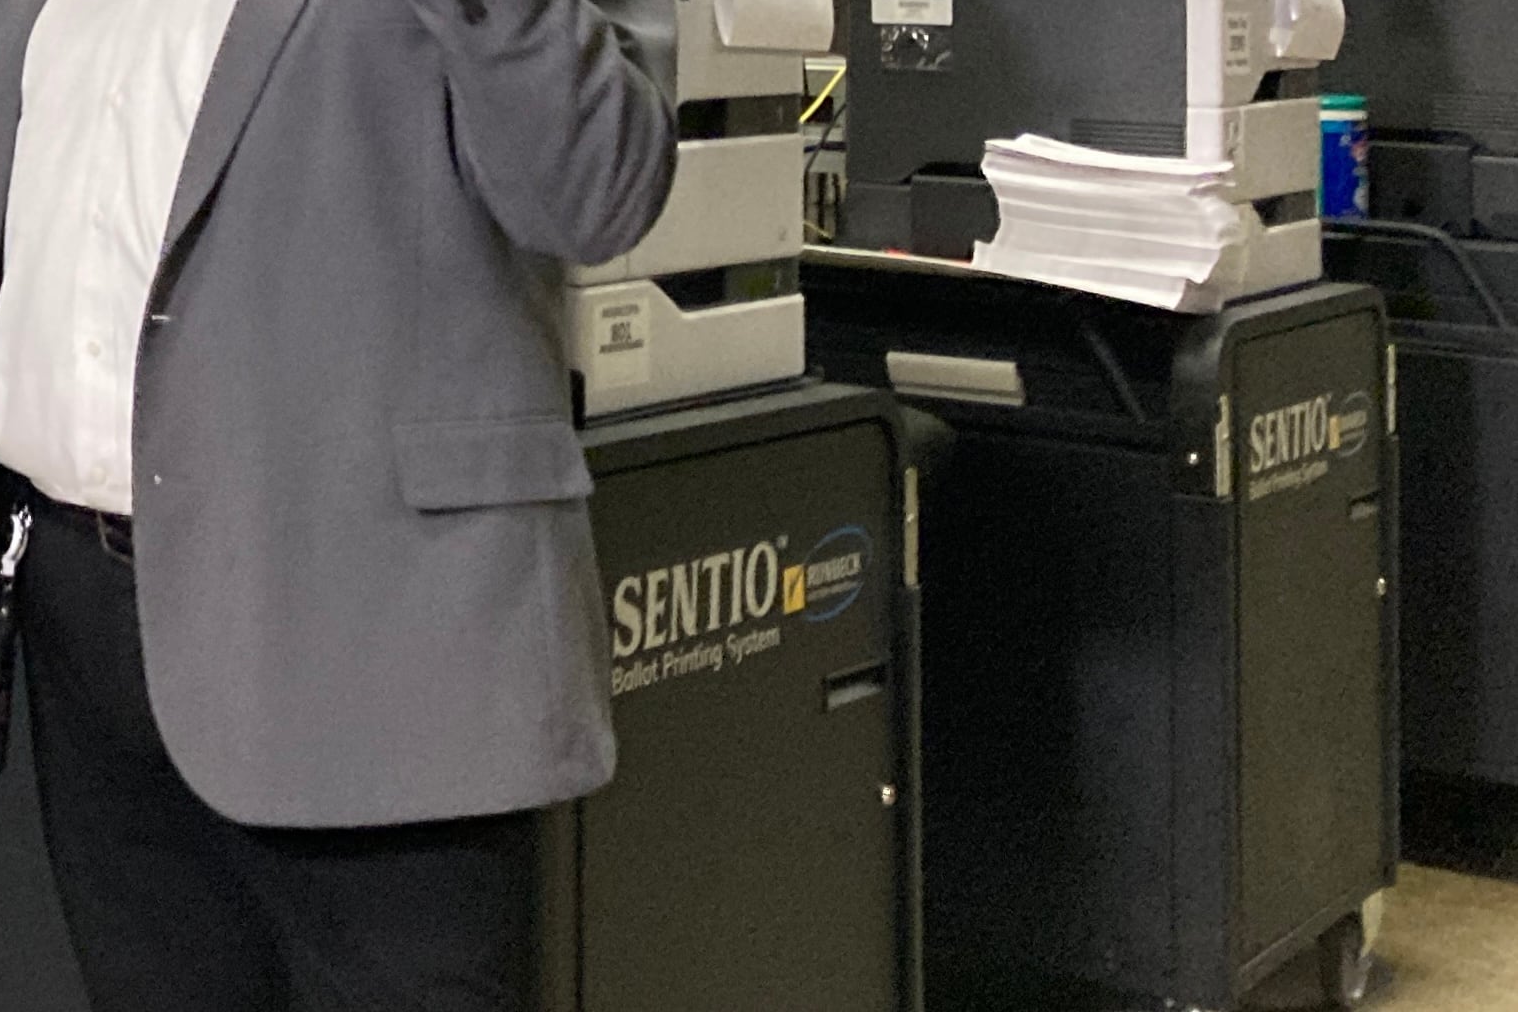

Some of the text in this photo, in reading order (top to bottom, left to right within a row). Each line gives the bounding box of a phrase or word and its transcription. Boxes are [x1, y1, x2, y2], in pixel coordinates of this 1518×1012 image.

[1249, 396, 1327, 473] SENTIO
[612, 541, 779, 658] SENTIO
[610, 626, 781, 697] Ballot Printing System
